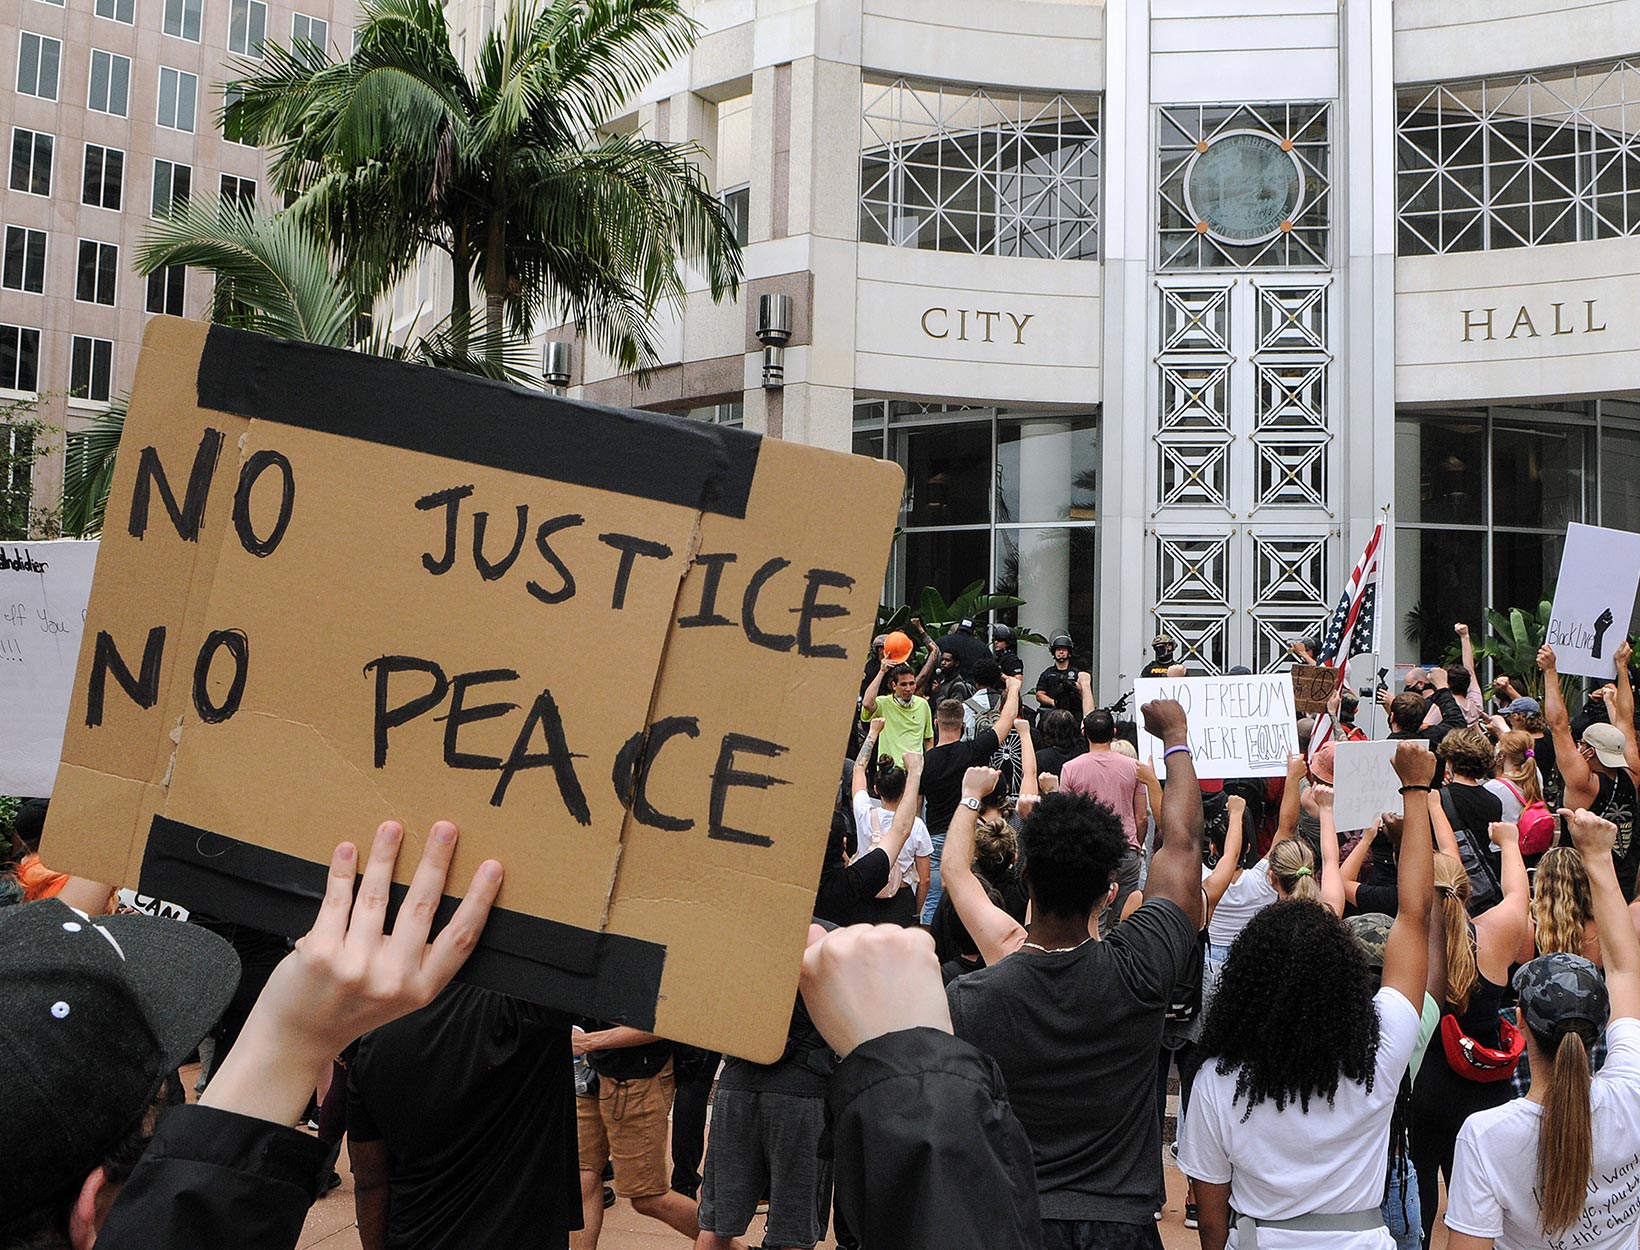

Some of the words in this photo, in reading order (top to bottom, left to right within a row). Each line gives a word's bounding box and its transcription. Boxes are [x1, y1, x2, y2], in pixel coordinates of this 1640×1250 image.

[920, 307, 1035, 345] CITY
[1460, 299, 1607, 343] HALL
[128, 427, 295, 558] NO
[415, 484, 857, 659] JUSTICE
[1205, 681, 1290, 718] FREEDOM
[86, 626, 249, 729] NO
[363, 653, 795, 848] PEACE
